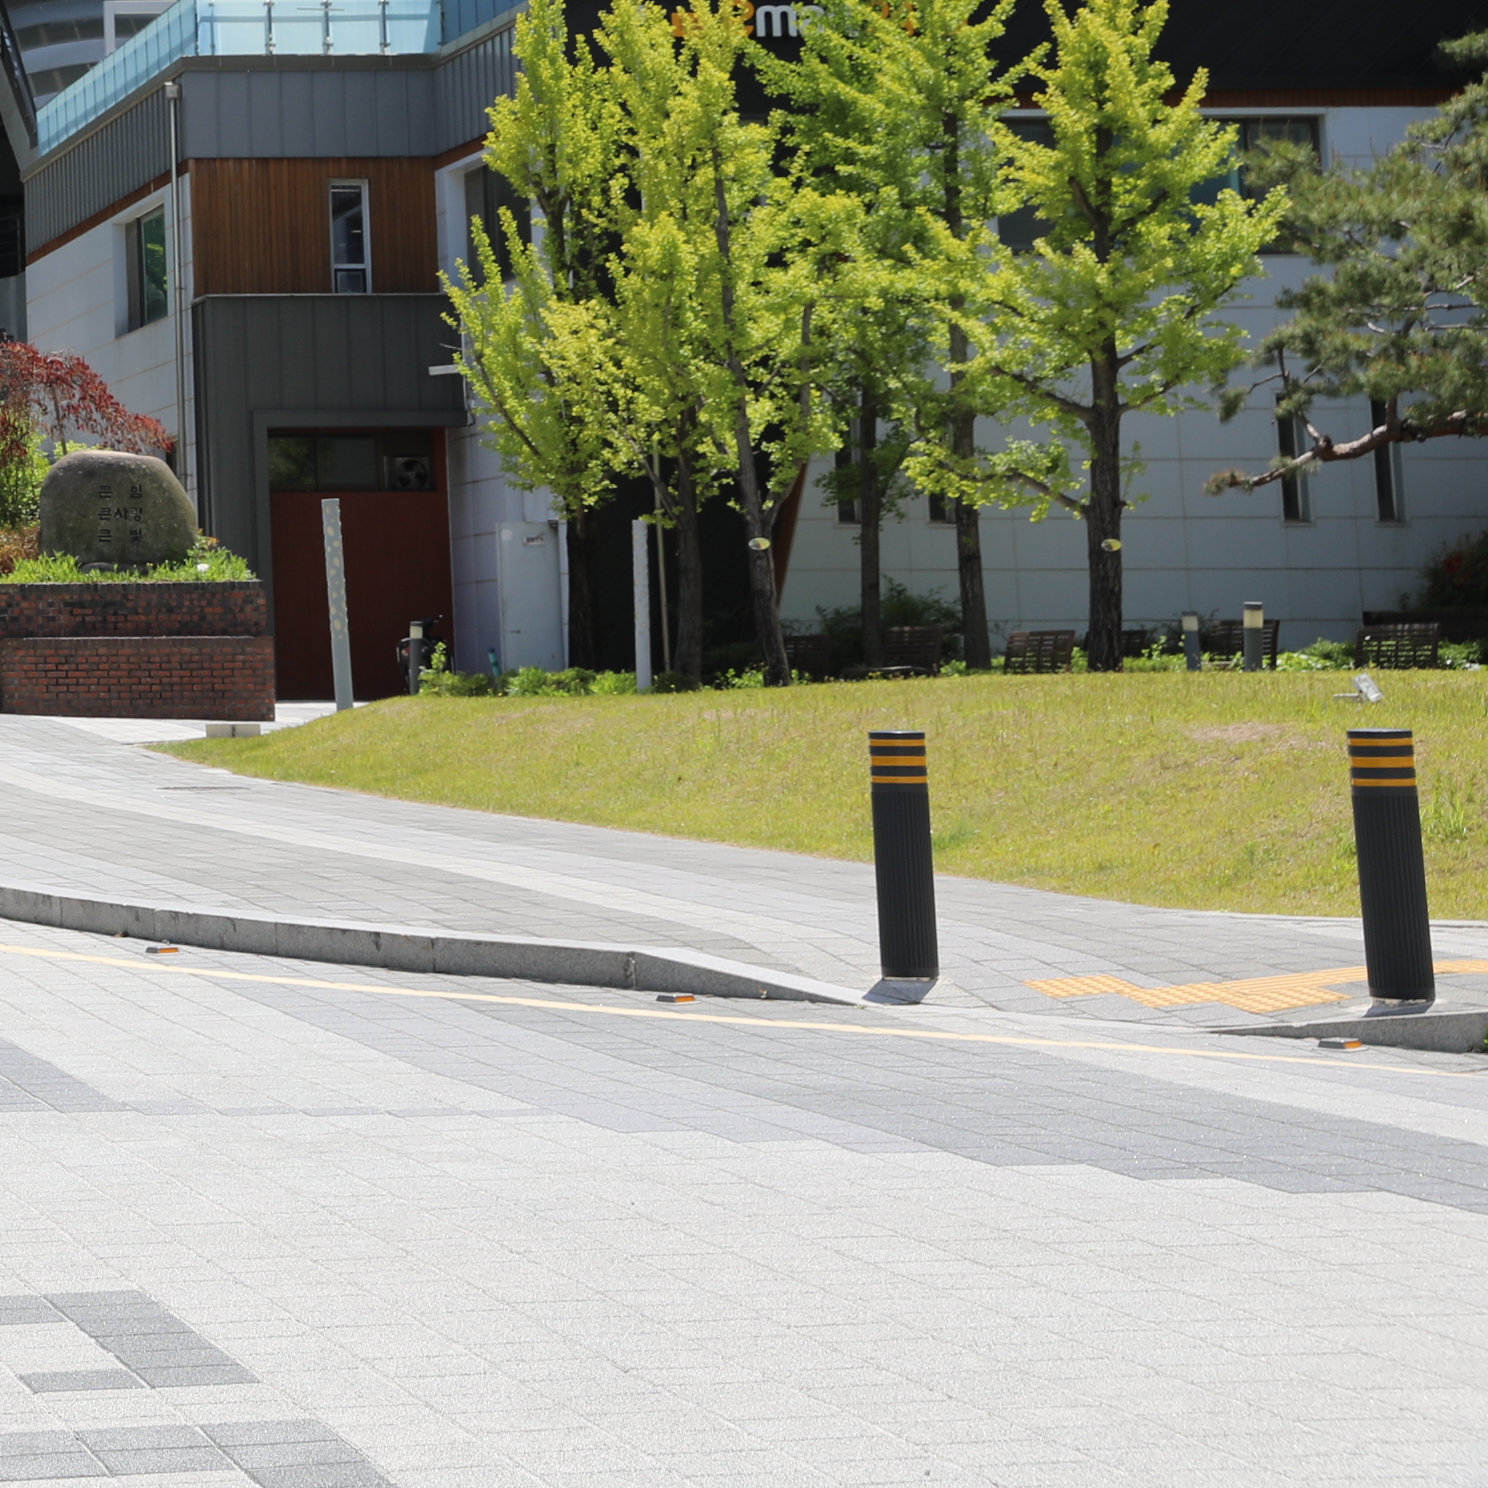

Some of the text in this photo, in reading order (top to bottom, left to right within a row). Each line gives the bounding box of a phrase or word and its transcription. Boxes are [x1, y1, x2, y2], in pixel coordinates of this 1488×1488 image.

[97, 484, 142, 499] 큰 힘
[97, 528, 112, 542] 큰
